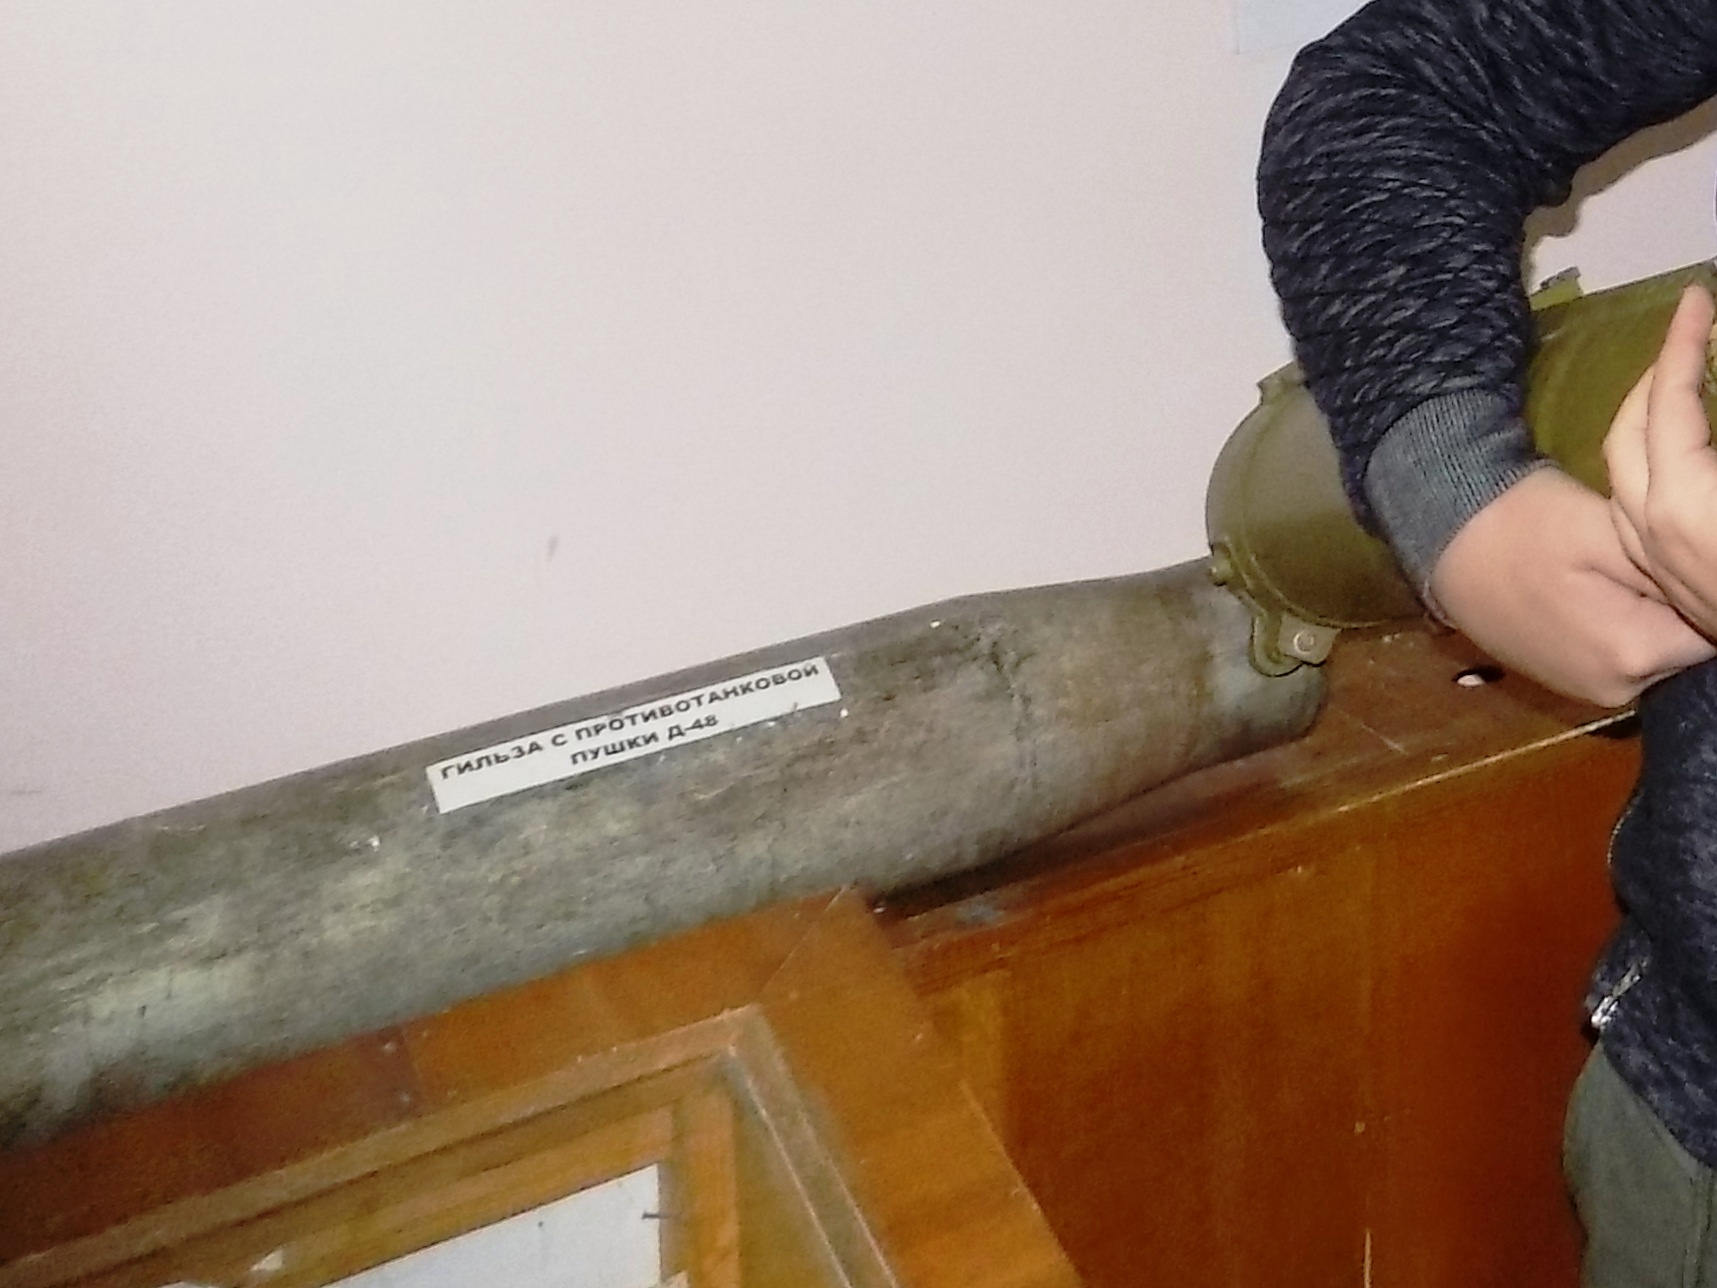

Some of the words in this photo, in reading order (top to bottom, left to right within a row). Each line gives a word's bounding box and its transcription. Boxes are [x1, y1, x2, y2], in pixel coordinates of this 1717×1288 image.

[440, 739, 544, 780] ГИЛЬЗА
[551, 732, 568, 748] С
[575, 663, 820, 741] ПРОТИВОТАНКОВОЙ
[570, 731, 660, 766] ПУШКИ
[667, 714, 719, 741] Д-48
